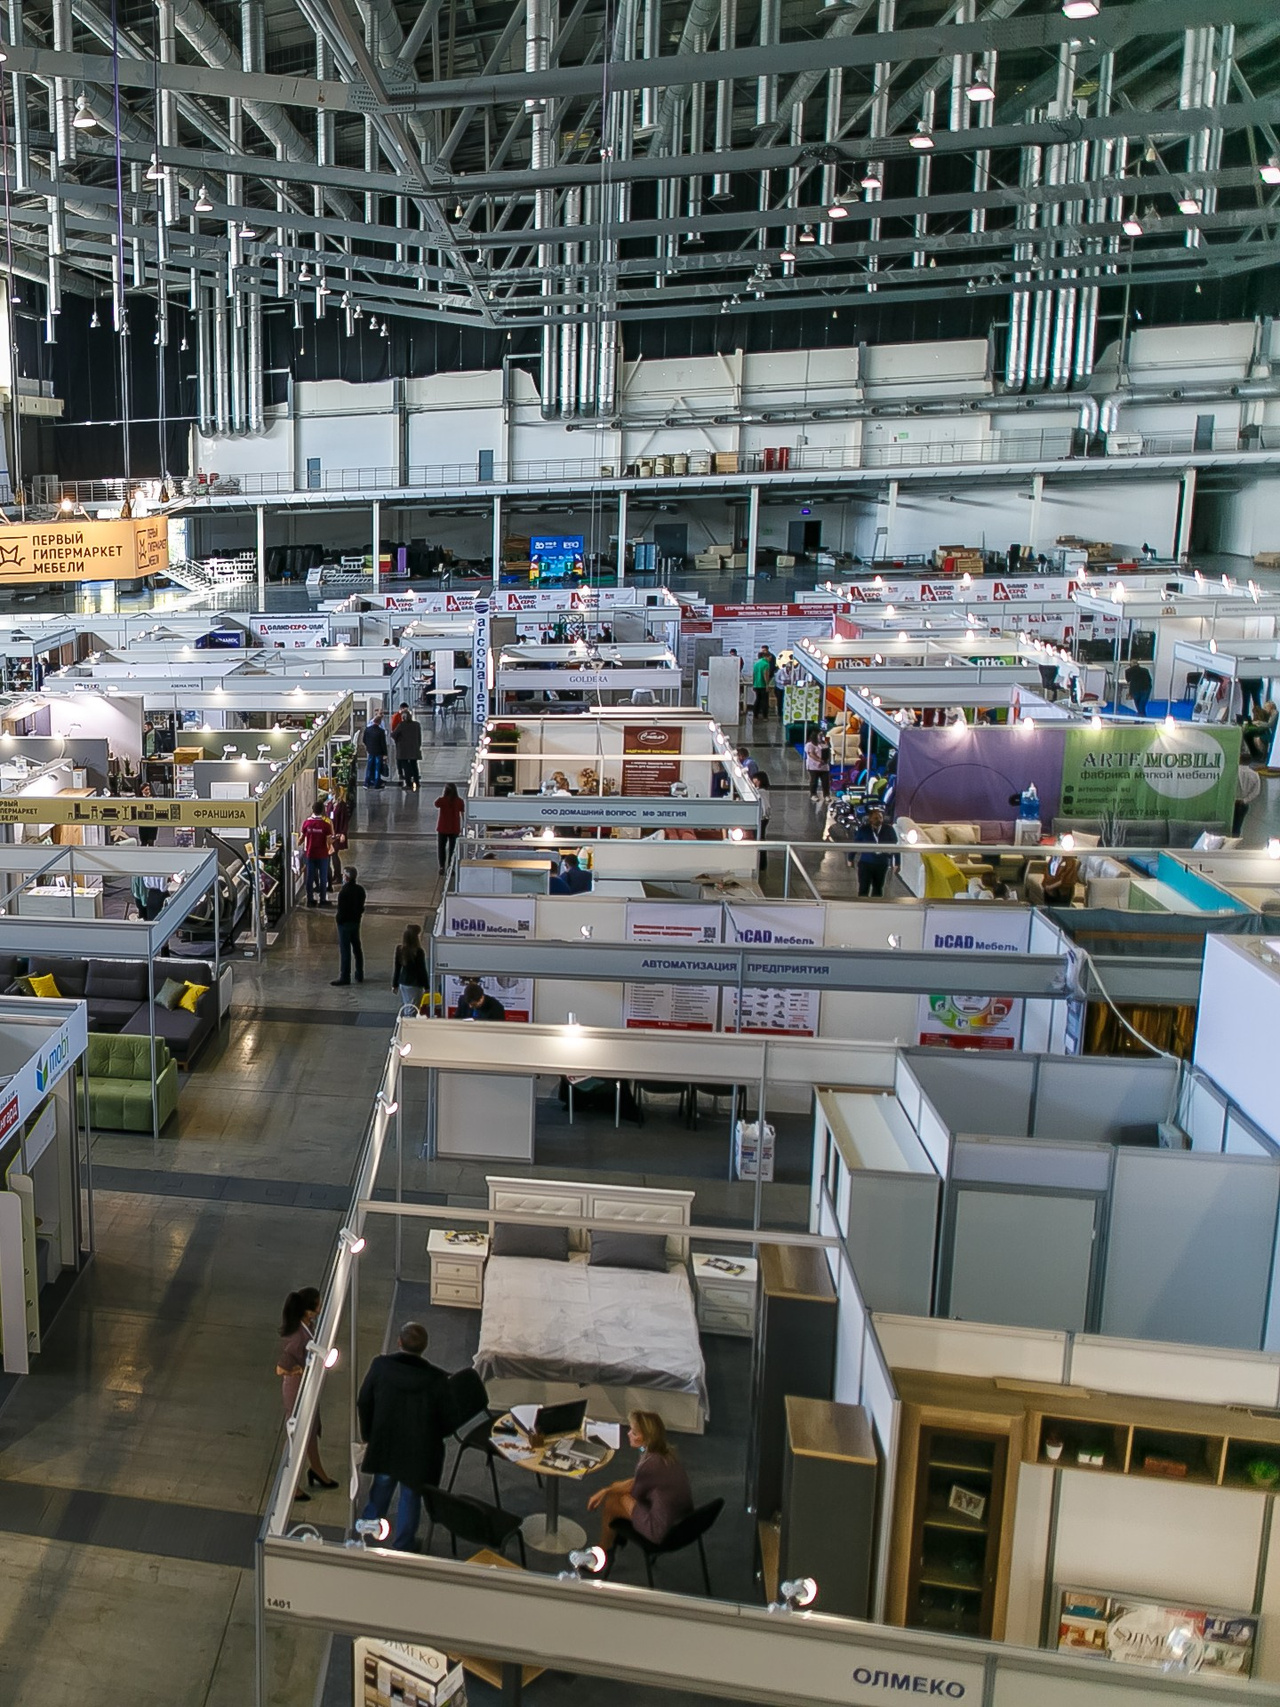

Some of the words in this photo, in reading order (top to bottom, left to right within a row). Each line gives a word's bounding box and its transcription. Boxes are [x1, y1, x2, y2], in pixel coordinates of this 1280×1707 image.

[32, 530, 84, 546] ПЕРВЫЙ
[33, 545, 123, 560] ГИПЕРМАРКЕТ
[34, 561, 84, 574] МЕБЕЛИ
[476, 617, 486, 723] arcobaleno
[569, 675, 608, 684] GOLDERA
[1083, 751, 1141, 768] ARTE
[1143, 751, 1223, 769] MOBILI
[1080, 770, 1131, 781] фабрика
[1134, 770, 1173, 780] мягкой
[1176, 769, 1221, 780] мебели
[193, 808, 246, 820] ФРАНШИЗА
[558, 808, 604, 817] ДОМАШНИЙ
[605, 809, 637, 817] ВОПРОС
[452, 918, 486, 932] bCAD
[486, 924, 518, 934] Мебель
[774, 934, 815, 945] Мебель
[934, 934, 974, 949] bCAD
[975, 941, 1018, 951] Мебель
[641, 958, 738, 971] АВТОМАТИЗАЦИЯ
[747, 963, 830, 975] ПРЕДПРИЯТИЯ
[266, 1597, 292, 1610] 1401
[852, 1666, 967, 1700] ОЛМЕКО
